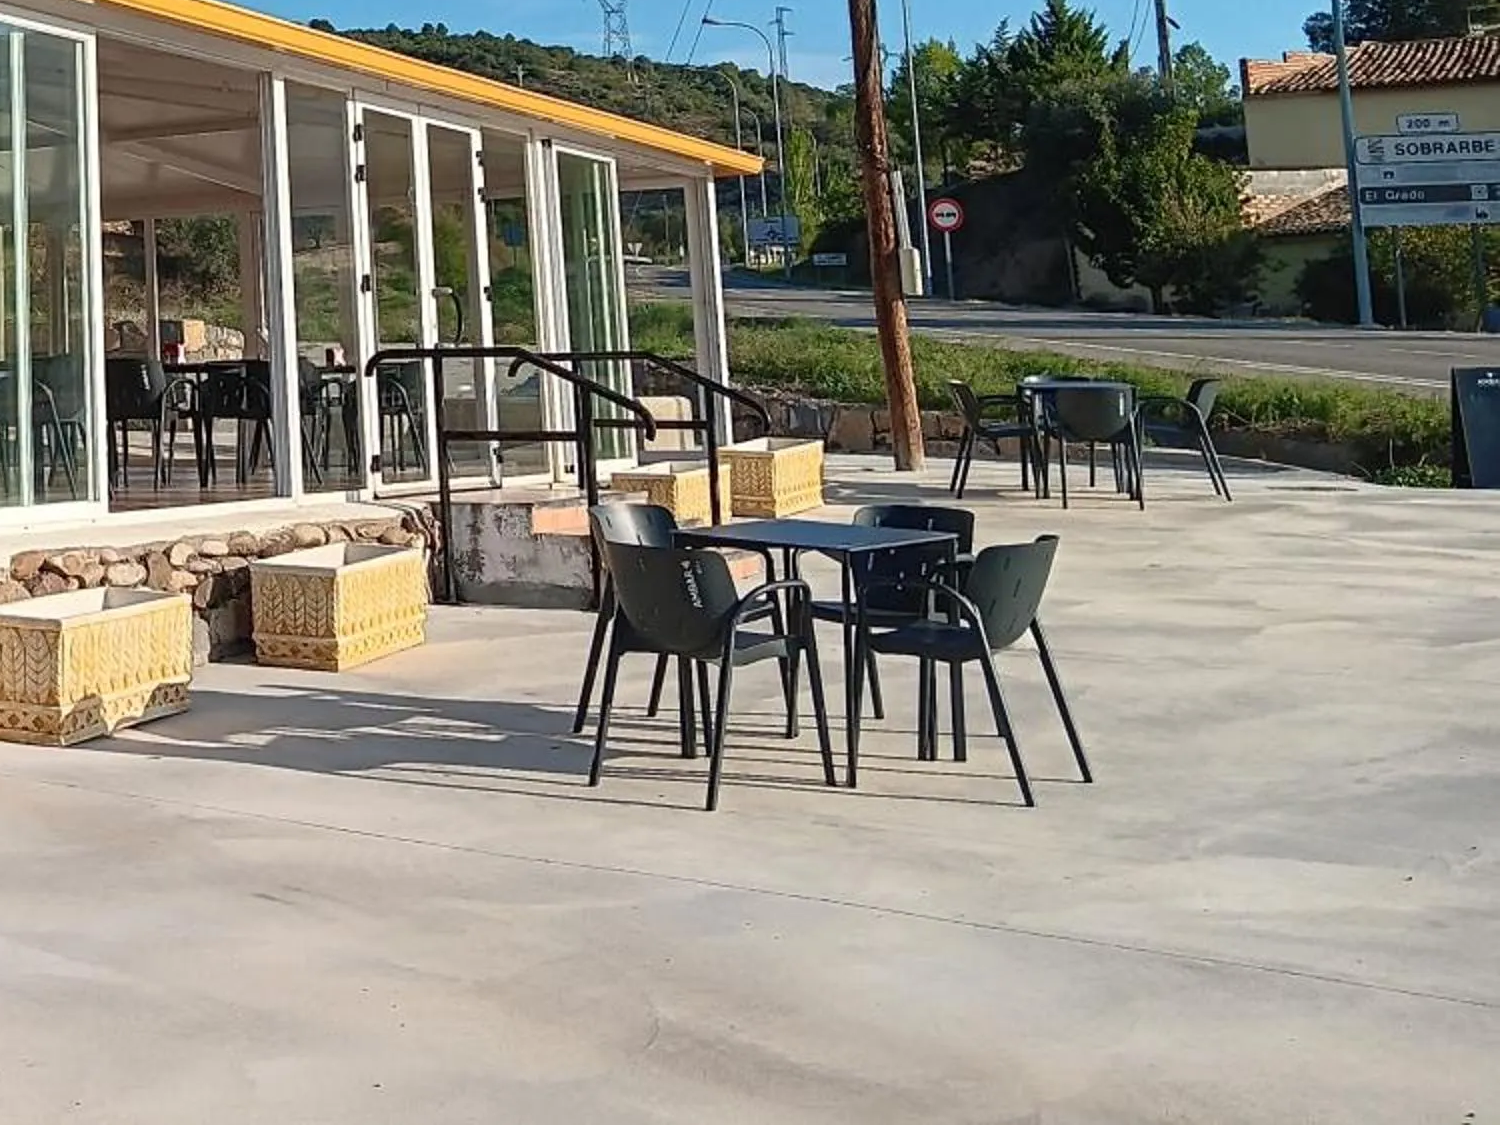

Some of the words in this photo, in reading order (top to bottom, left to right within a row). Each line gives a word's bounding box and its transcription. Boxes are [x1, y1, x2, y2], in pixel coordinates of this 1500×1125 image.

[1406, 118, 1431, 129] 200
[1438, 120, 1450, 128] m
[1394, 140, 1495, 156] SOBRARBE
[1365, 191, 1377, 201] El
[1385, 190, 1425, 200] Grado
